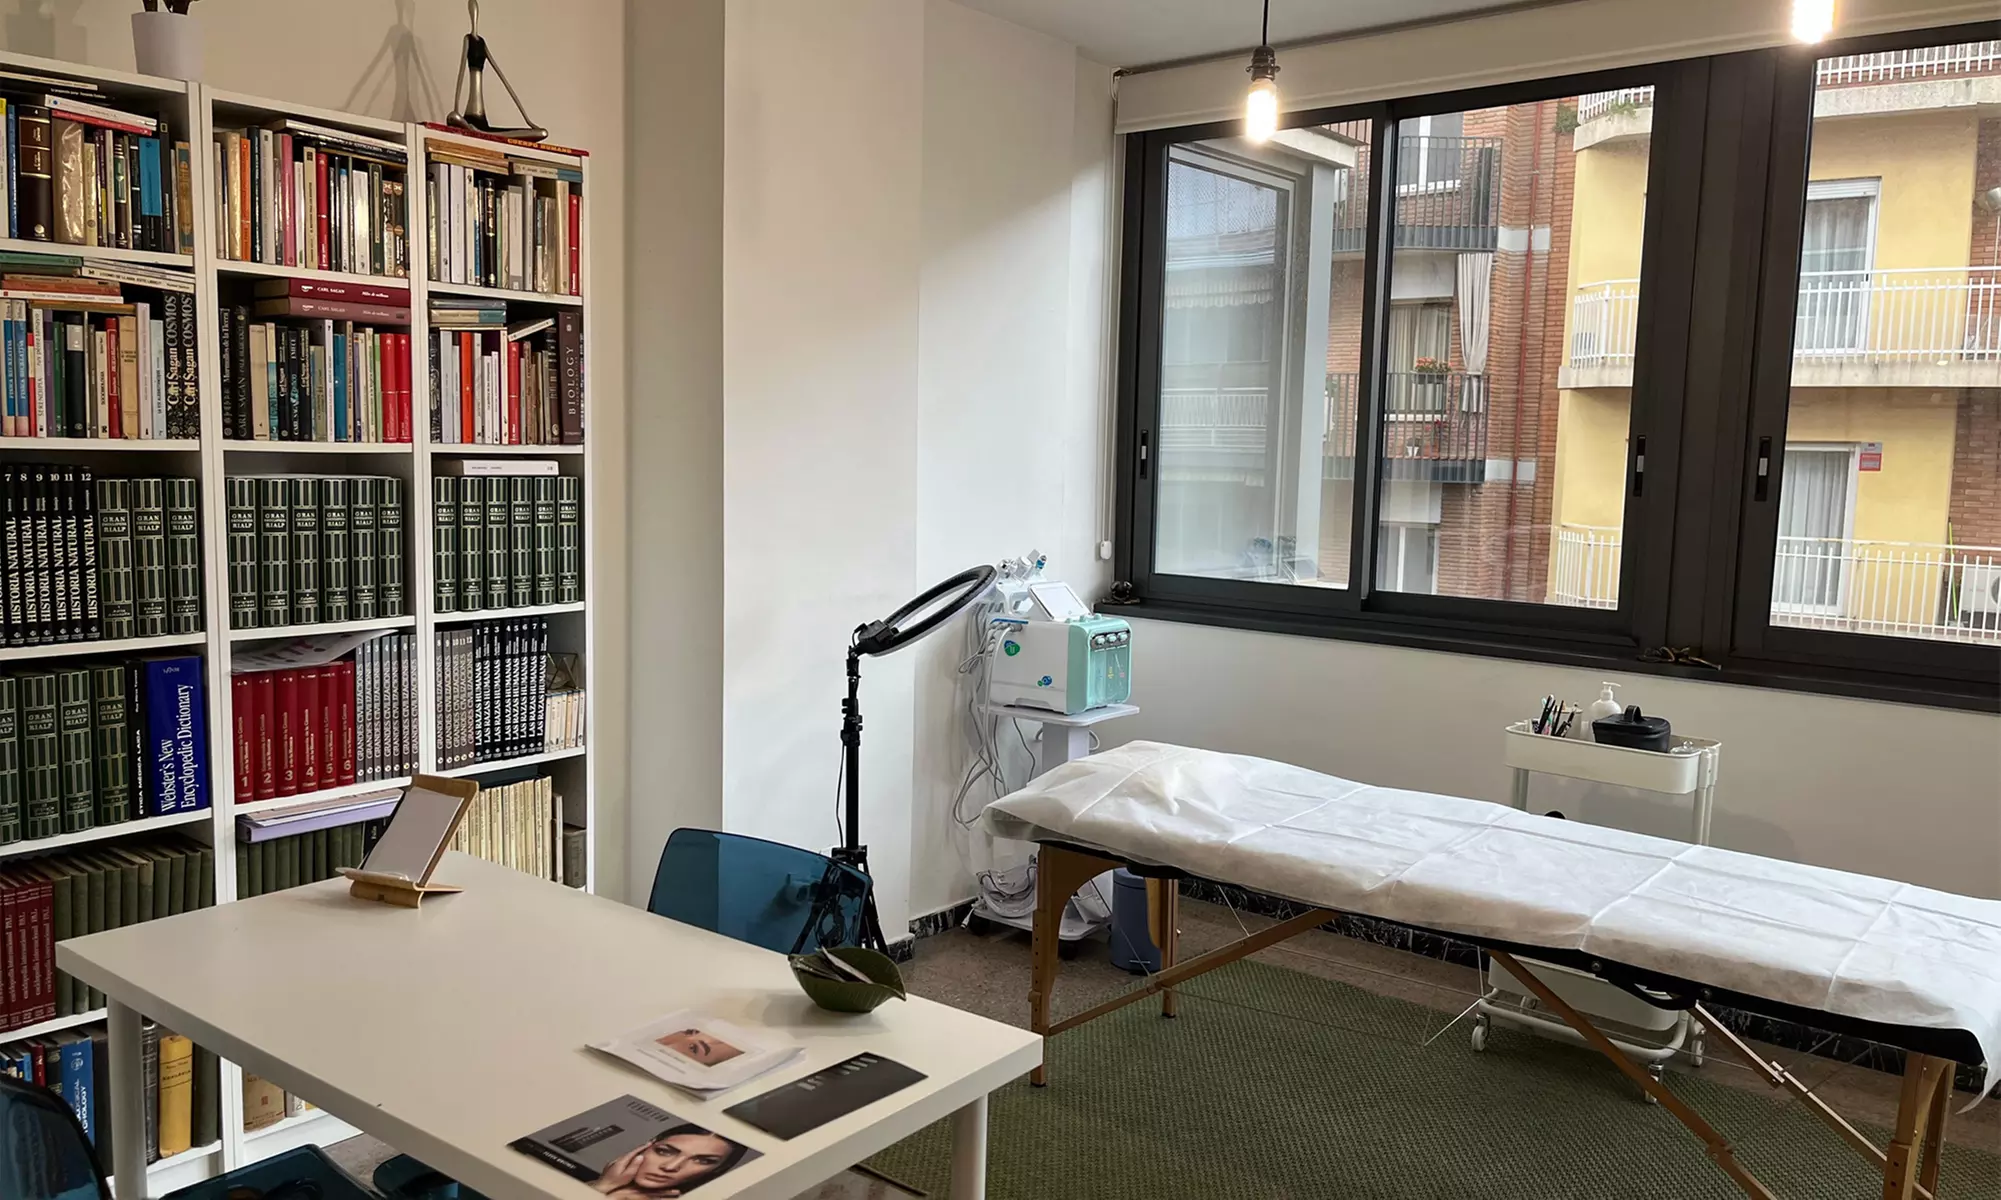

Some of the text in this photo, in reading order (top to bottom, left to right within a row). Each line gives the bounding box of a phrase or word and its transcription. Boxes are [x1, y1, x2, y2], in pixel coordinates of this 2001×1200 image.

[508, 138, 572, 153] CUERPO HUMANO
[165, 295, 181, 406] Carl Sagan COSMOS
[182, 294, 197, 406] Carl Sagan COSMOS
[566, 346, 576, 415] BIOLOGY
[81, 473, 91, 481] 12
[6, 517, 18, 569] NATURAL
[21, 516, 34, 568] NATURAL
[36, 516, 48, 568] NATURAL
[52, 516, 64, 567] NATURAL
[66, 516, 78, 567] NATURAL
[84, 515, 96, 566] NATURAL
[9, 572, 21, 624] HISTORIA
[24, 571, 37, 623] HISTORIA
[39, 570, 51, 622] HISTORIA
[55, 569, 67, 621] HISTORIA
[69, 569, 81, 620] HISTORIA
[86, 568, 98, 619] HISTORIA
[176, 684, 199, 808] Encyclopedic Dictionary
[306, 766, 314, 777] 4
[326, 763, 333, 774] 5
[344, 760, 351, 770] 6
[158, 739, 176, 812] Webster's New
[241, 777, 248, 787] 1
[264, 773, 272, 783] 2
[285, 770, 293, 780] 3
